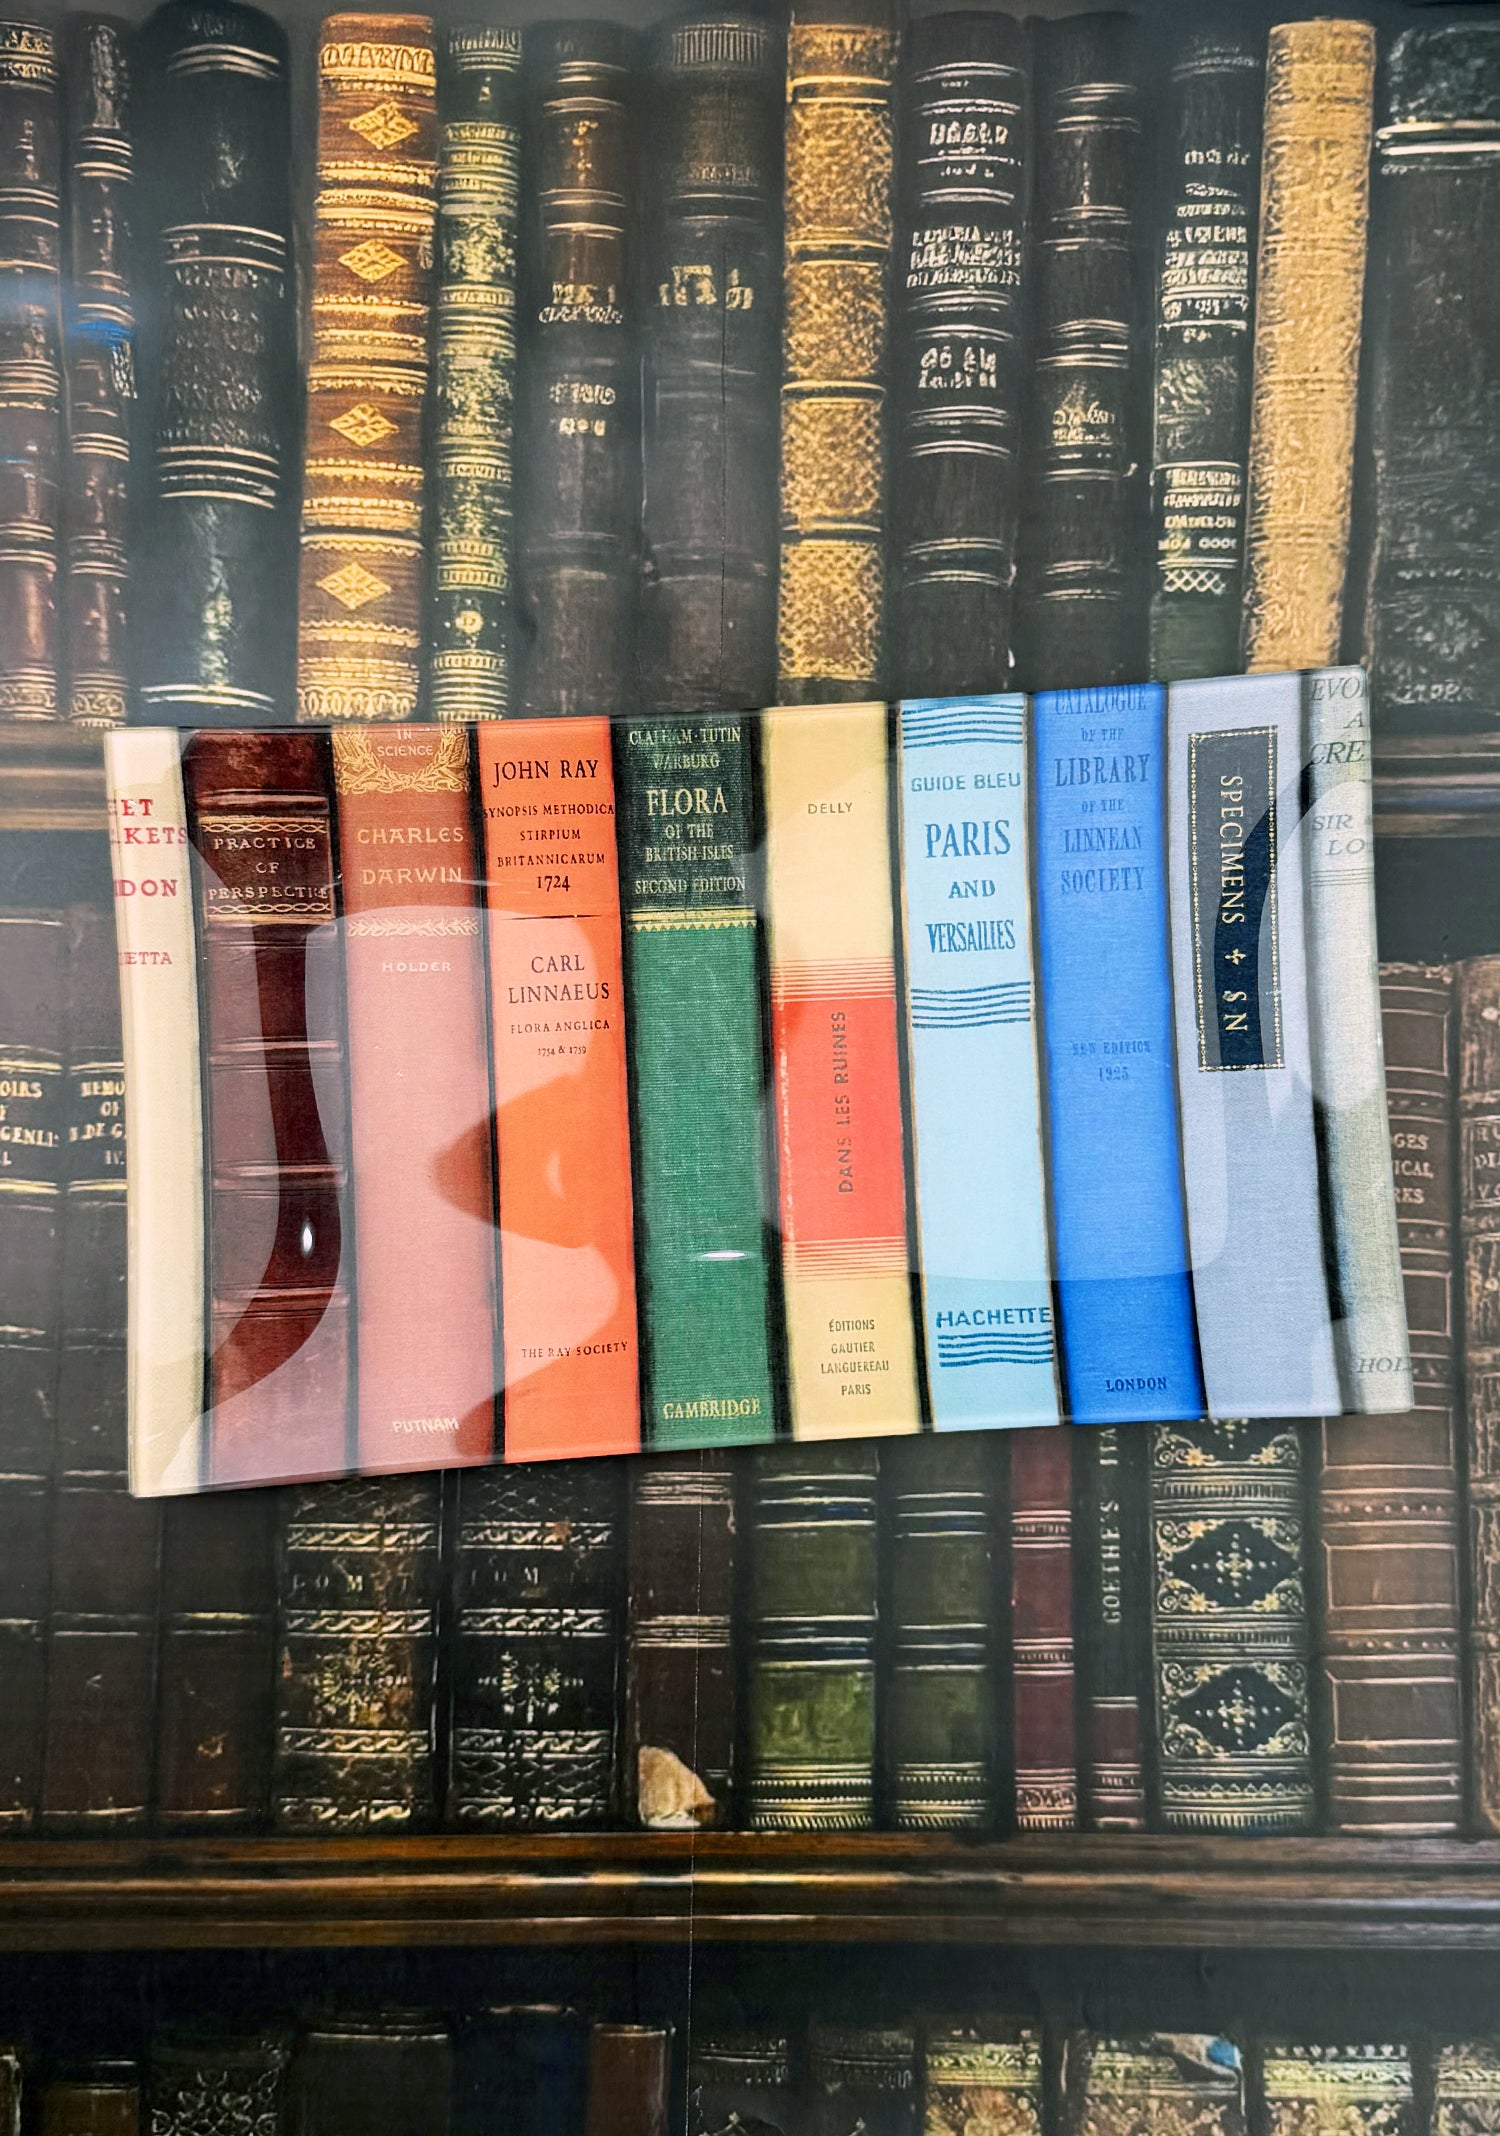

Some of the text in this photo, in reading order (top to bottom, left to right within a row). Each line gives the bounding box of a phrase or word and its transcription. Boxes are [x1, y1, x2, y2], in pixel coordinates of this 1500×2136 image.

[1054, 684, 1147, 715] CATALOGUE
[396, 728, 412, 740] IN
[699, 727, 741, 743] TUTIN
[1080, 727, 1125, 742] OF THE
[377, 745, 434, 757] SCIENCE
[493, 759, 599, 788] JOHN RAY
[1054, 754, 1150, 787] LIBRARY
[911, 772, 1021, 793] GUIDE BLEU
[646, 786, 728, 816] FLORA
[807, 801, 853, 815] DELLY
[1081, 798, 1124, 813] OF THE
[484, 803, 615, 819] SYNOPSIS METHODICA
[1311, 813, 1354, 832] SIR
[112, 826, 188, 845] KETS
[357, 827, 464, 844] CHARLES
[520, 829, 581, 842] STIRPIUM
[665, 824, 714, 839] OF THE
[924, 819, 1011, 858] PARIS
[1064, 826, 1144, 852] LINNEAN
[213, 836, 316, 850] PRACTICE
[1219, 775, 1245, 925] SPECIMENS
[498, 853, 606, 868] BRITANNICARUM
[645, 845, 734, 862] BRITISH ISLES
[255, 862, 280, 874] OF
[362, 867, 462, 885] DARWIN
[537, 875, 571, 892] 1724
[635, 876, 746, 895] SECOND EDITION
[1061, 866, 1145, 894] SOCIETY
[948, 879, 996, 899] AND
[925, 919, 1016, 954] VERSAILLES
[118, 951, 173, 965] ETTA
[531, 954, 585, 974] CARL
[382, 961, 452, 973] HOLDER
[508, 982, 610, 1004] LINNAEUS
[511, 1019, 610, 1035] FLORA ANGLICA
[558, 1045, 566, 1054] &
[1103, 1040, 1151, 1054] EDITION
[831, 1011, 854, 1193] DANS LES RUINES
[828, 1318, 875, 1333] ÉDITIONS
[936, 1306, 1053, 1329] HACHETTE
[521, 1341, 628, 1358] THE RAY SOCIETY
[831, 1341, 876, 1355] GAUTIER
[820, 1360, 890, 1375] LANGUEREAU
[841, 1383, 872, 1396] PARIS
[1105, 1376, 1167, 1393] LONDON
[663, 1398, 761, 1420] CAMBRIDGE
[391, 1417, 459, 1434] PUTNAM
[1100, 1500, 1122, 1625] GOETHE'S
